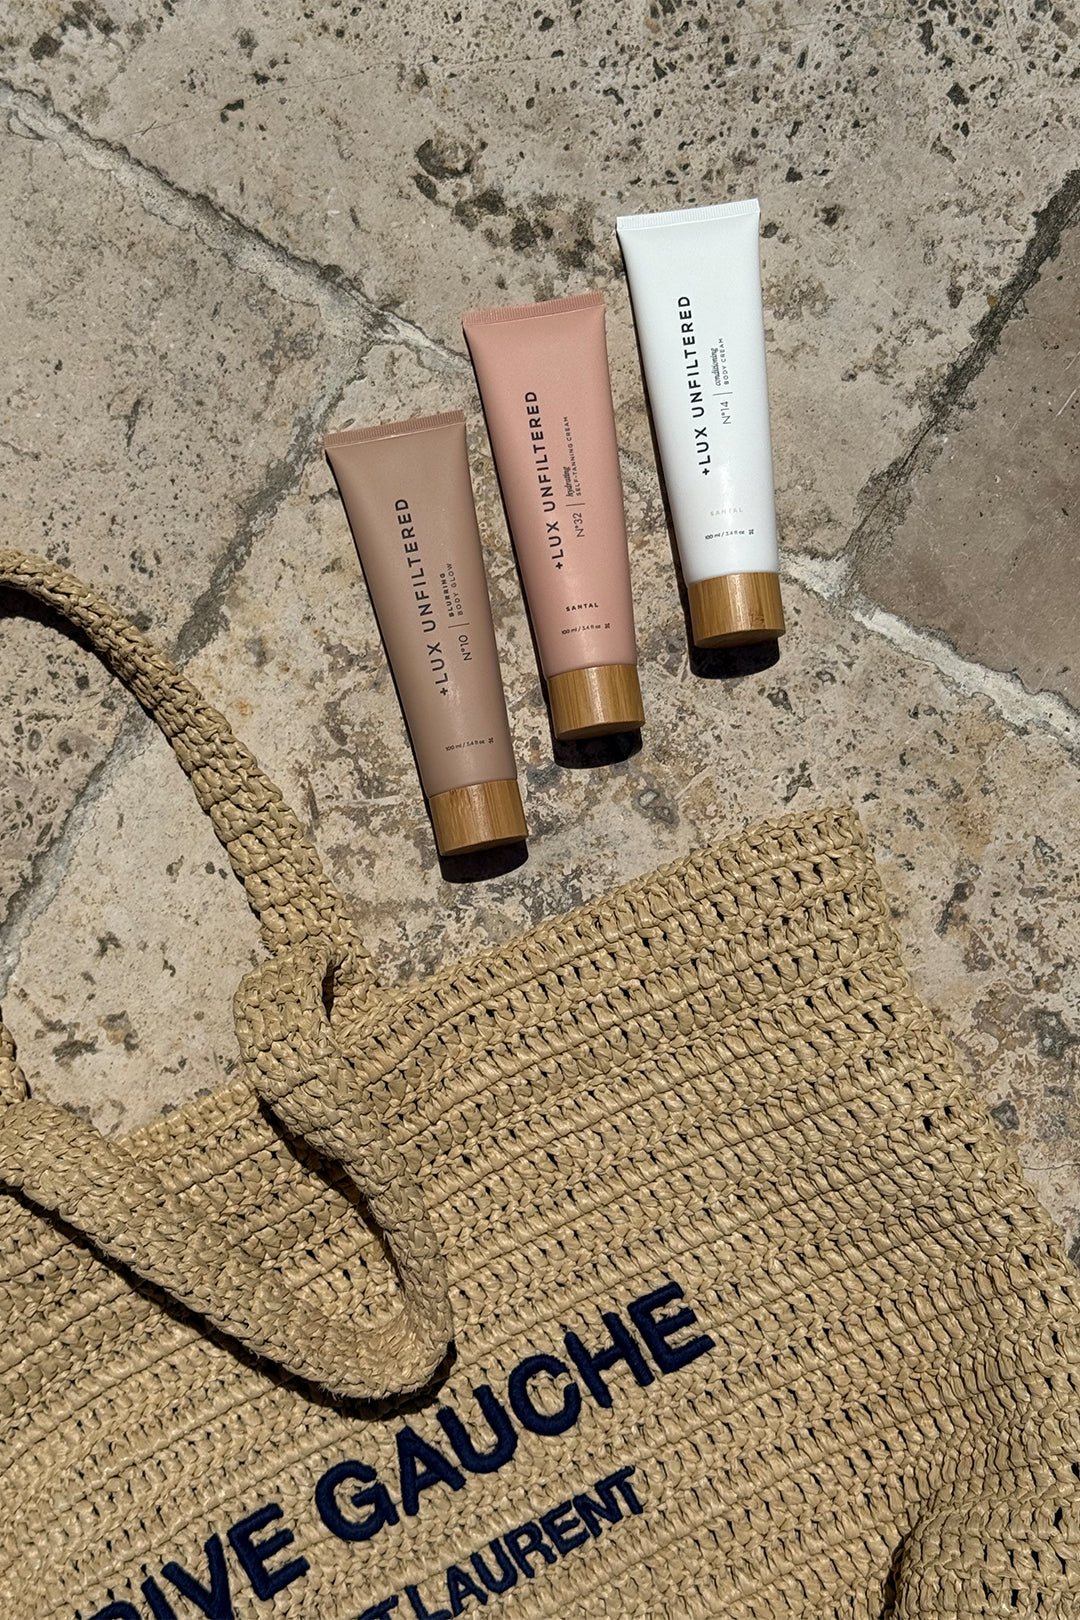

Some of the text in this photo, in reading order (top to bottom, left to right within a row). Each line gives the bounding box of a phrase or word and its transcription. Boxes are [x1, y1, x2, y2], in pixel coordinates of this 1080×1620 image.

[678, 296, 706, 419] UNFILTERED
[711, 347, 722, 387] conditioning
[718, 337, 731, 386] BODY CREAM
[524, 391, 556, 512] UNFILTERED
[563, 416, 582, 497] SELF-TANNING CREAM
[562, 466, 574, 498] hydrating
[709, 506, 744, 517] SANTAL
[394, 498, 436, 633] UNFILTERED
[446, 562, 464, 616] BODY GLOW
[439, 572, 455, 618] BLURRING
[565, 602, 599, 612] SANTAL
[88, 1281, 715, 1620] IVE GAUCHE
[404, 1465, 644, 1620] LAURENT
